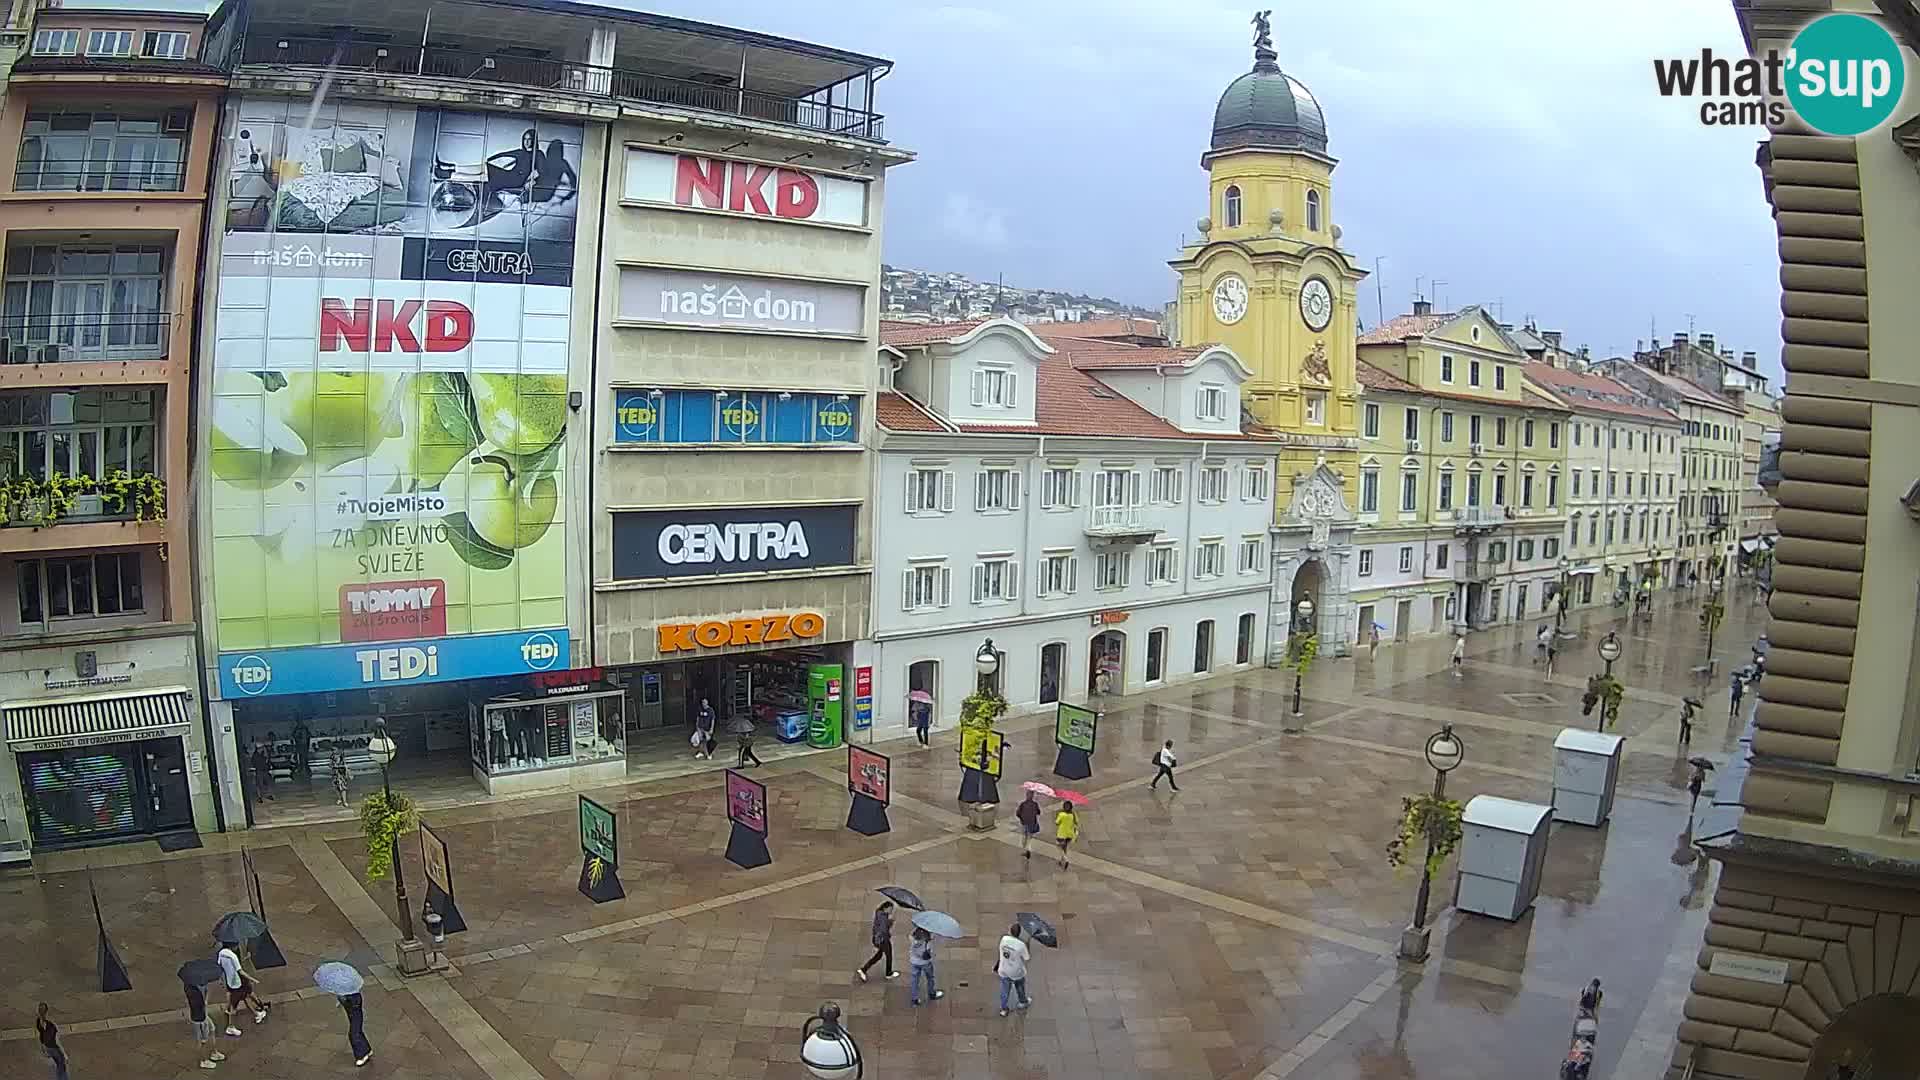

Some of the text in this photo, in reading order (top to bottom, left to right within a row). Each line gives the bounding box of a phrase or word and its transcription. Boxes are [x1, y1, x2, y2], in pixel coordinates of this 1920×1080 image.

[675, 156, 819, 219] NKD
[252, 244, 364, 268] naš dom
[446, 249, 533, 275] CENTRA
[660, 283, 815, 322] naš dom
[320, 297, 474, 353] NKD
[618, 407, 657, 425] TEDi
[722, 408, 759, 425] TEDi
[819, 411, 852, 427] TEDi
[336, 496, 445, 515] #TvojeMisto
[332, 523, 449, 549] ZA DNEVNO
[658, 520, 809, 564] CENTRA
[358, 549, 425, 575] SVJEŽE
[347, 586, 437, 613] TOMMY
[658, 613, 825, 652] KORZO
[356, 645, 438, 684] TEDi
[520, 644, 558, 660] TEDi
[231, 666, 272, 683] TEDi
